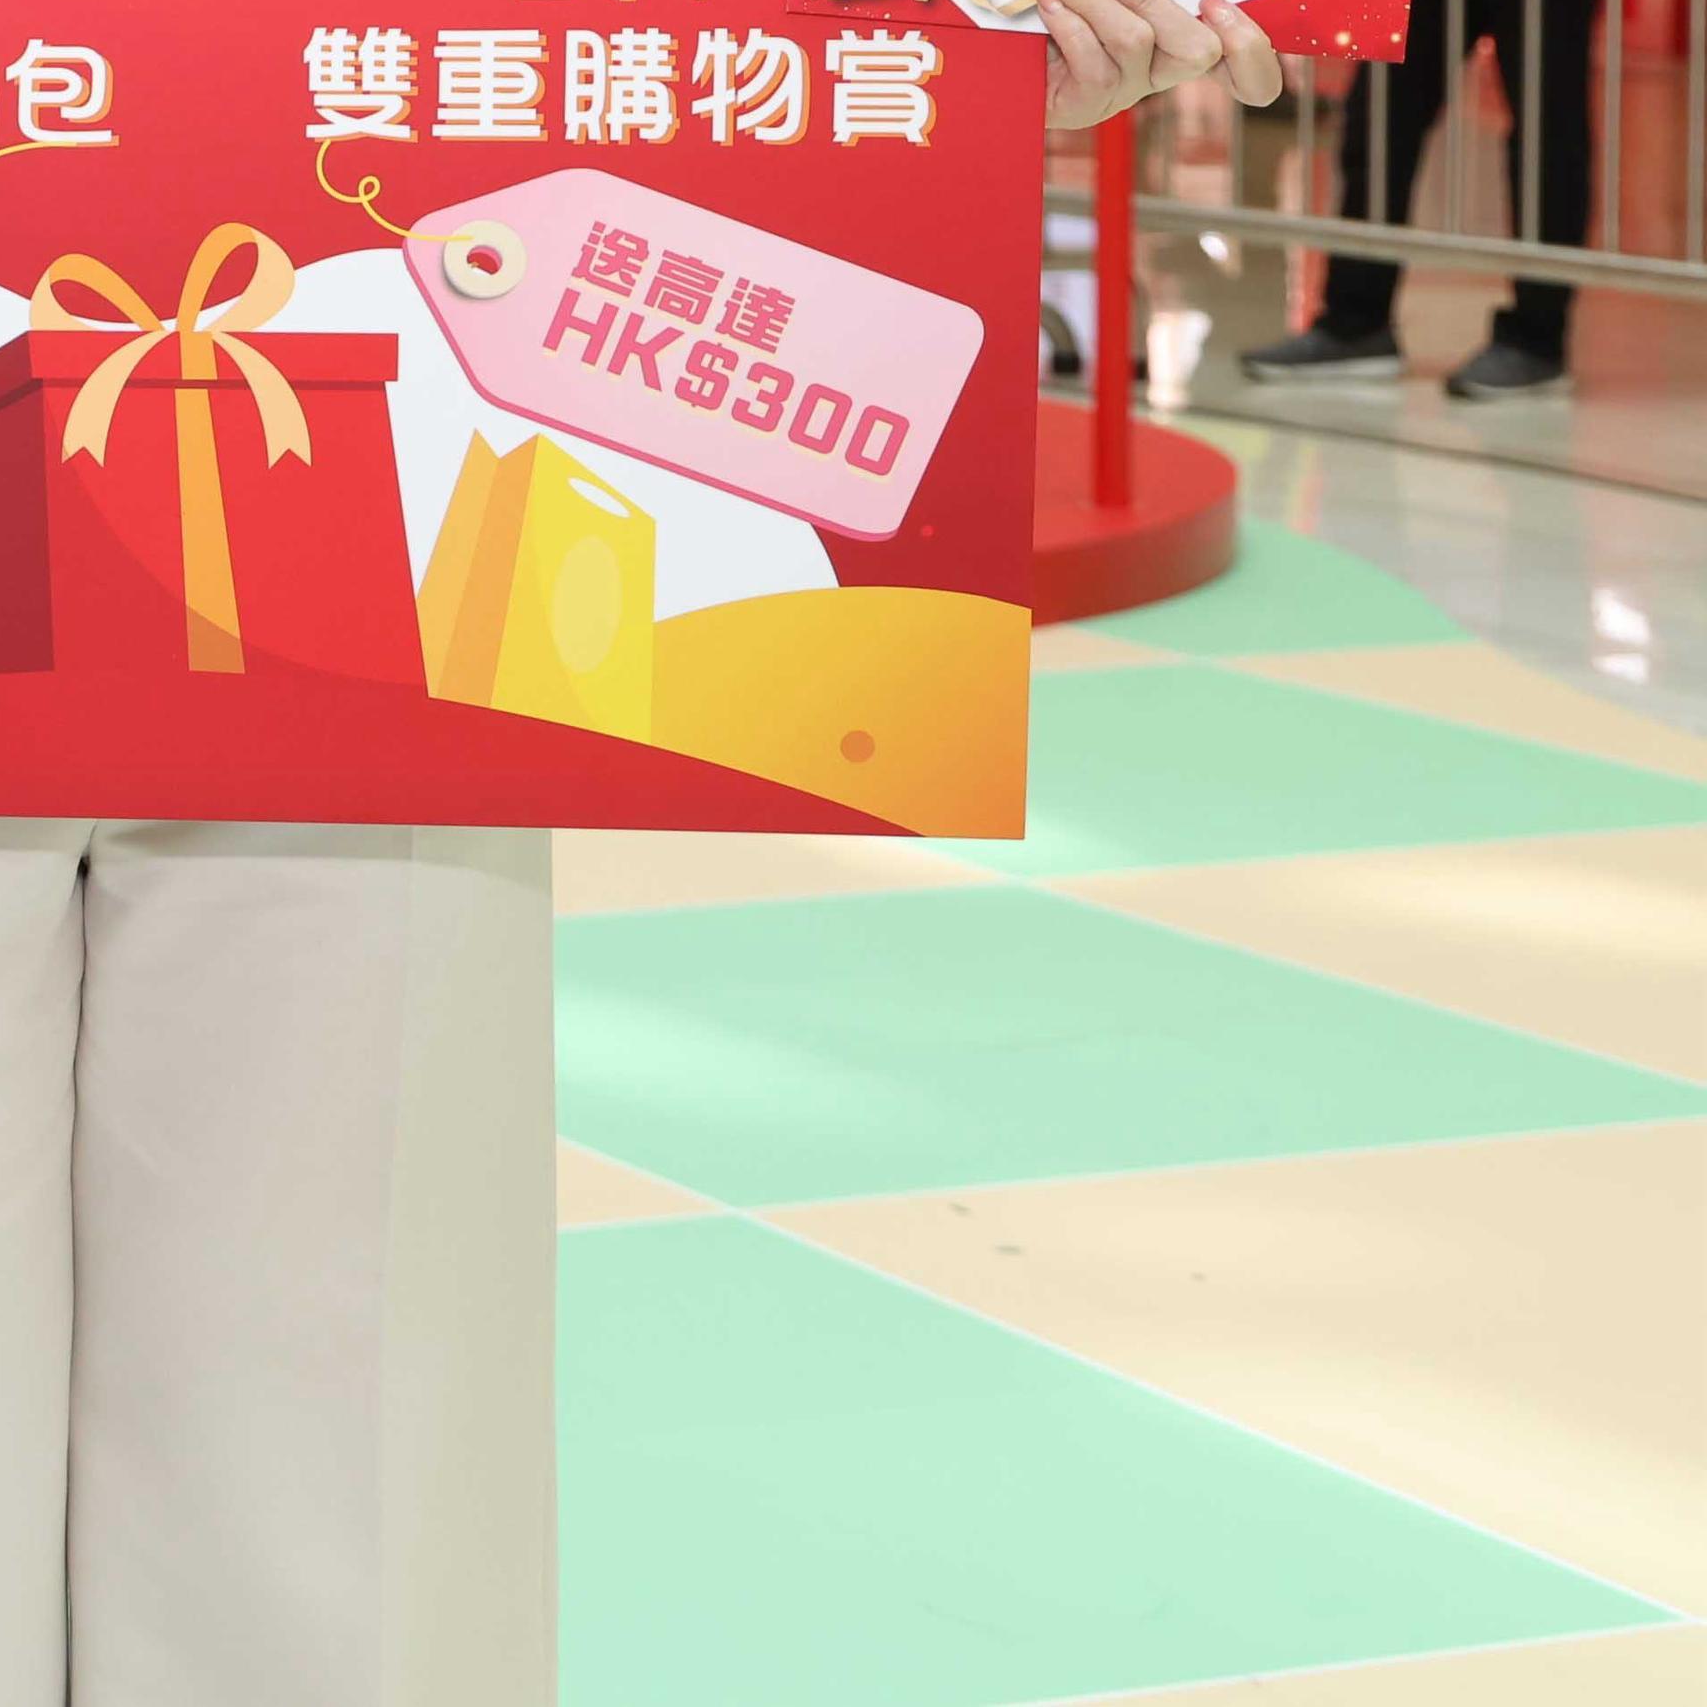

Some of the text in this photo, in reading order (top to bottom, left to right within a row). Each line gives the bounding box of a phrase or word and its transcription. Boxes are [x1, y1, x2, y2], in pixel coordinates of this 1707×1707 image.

[301, 26, 943, 147] 雙重購物賞
[569, 220, 797, 356] 送高達
[541, 290, 913, 481] HK$300
